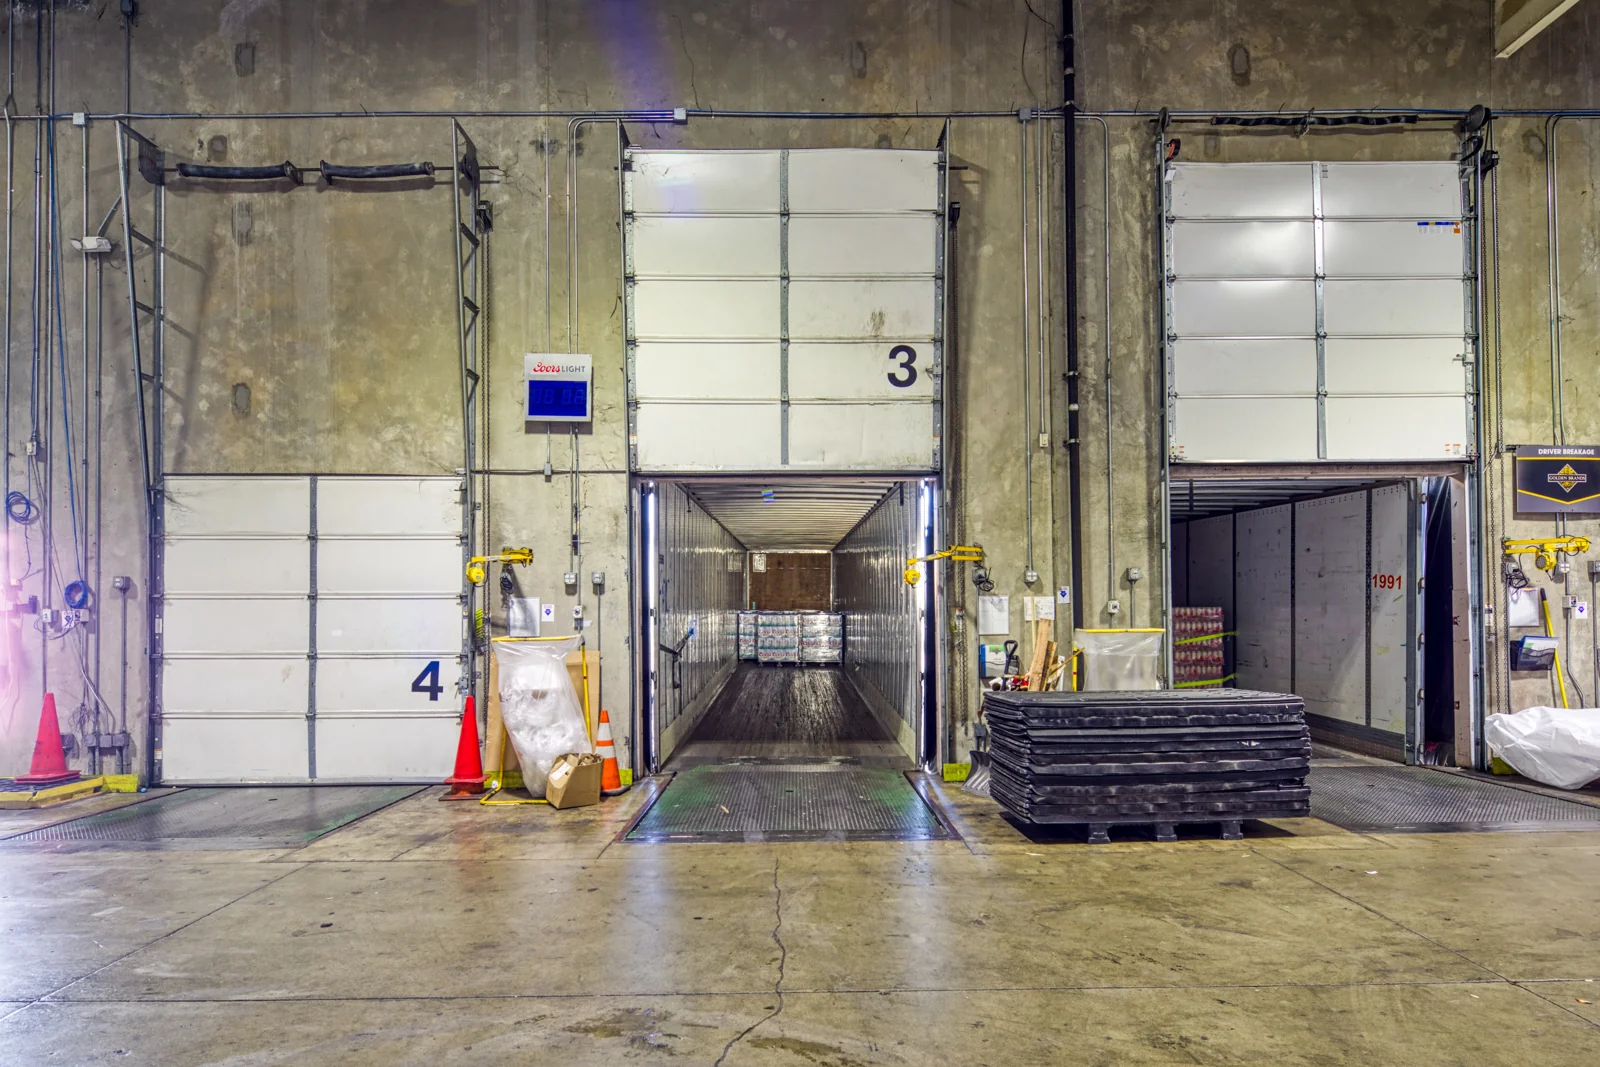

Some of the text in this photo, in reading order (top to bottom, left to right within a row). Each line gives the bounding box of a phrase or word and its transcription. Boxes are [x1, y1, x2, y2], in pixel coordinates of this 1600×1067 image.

[533, 361, 586, 373] Coors LIGHT
[887, 344, 918, 388] 3
[1562, 448, 1595, 456] BREAKAGE
[1372, 574, 1402, 590] 1991
[411, 660, 444, 701] 4
